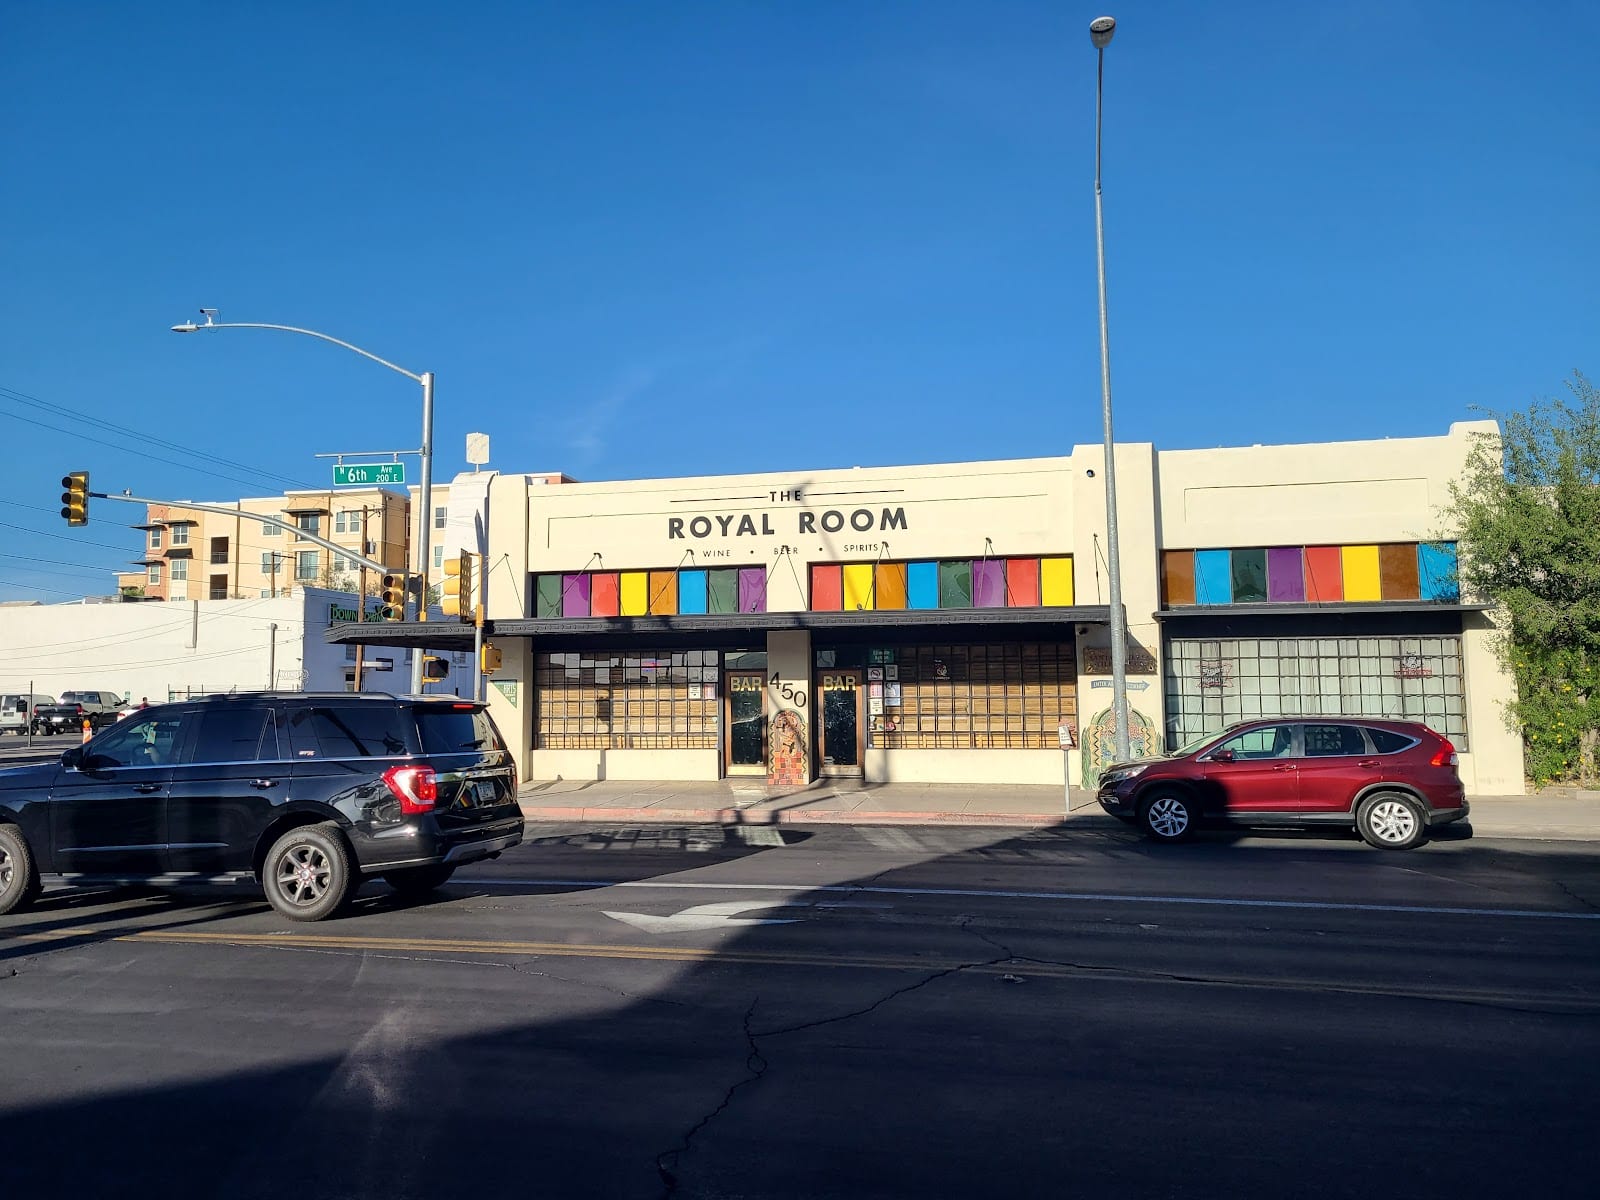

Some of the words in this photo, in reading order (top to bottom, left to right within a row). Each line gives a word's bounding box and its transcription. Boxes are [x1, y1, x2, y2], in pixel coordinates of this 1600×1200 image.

[339, 466, 345, 474] N
[347, 468, 367, 483] 6th
[381, 465, 393, 473] Ave
[375, 474, 389, 482] 200
[393, 473, 399, 482] E
[769, 490, 801, 502] THE
[668, 513, 775, 539] ROYAL
[799, 507, 908, 534] ROOM
[702, 549, 731, 558] WINE
[773, 547, 798, 555] BEER
[843, 543, 879, 553] SPIRITS
[332, 607, 382, 622] DOWNOWN
[730, 676, 762, 692] BAR
[769, 672, 807, 708] 450
[823, 675, 857, 692] BAR
